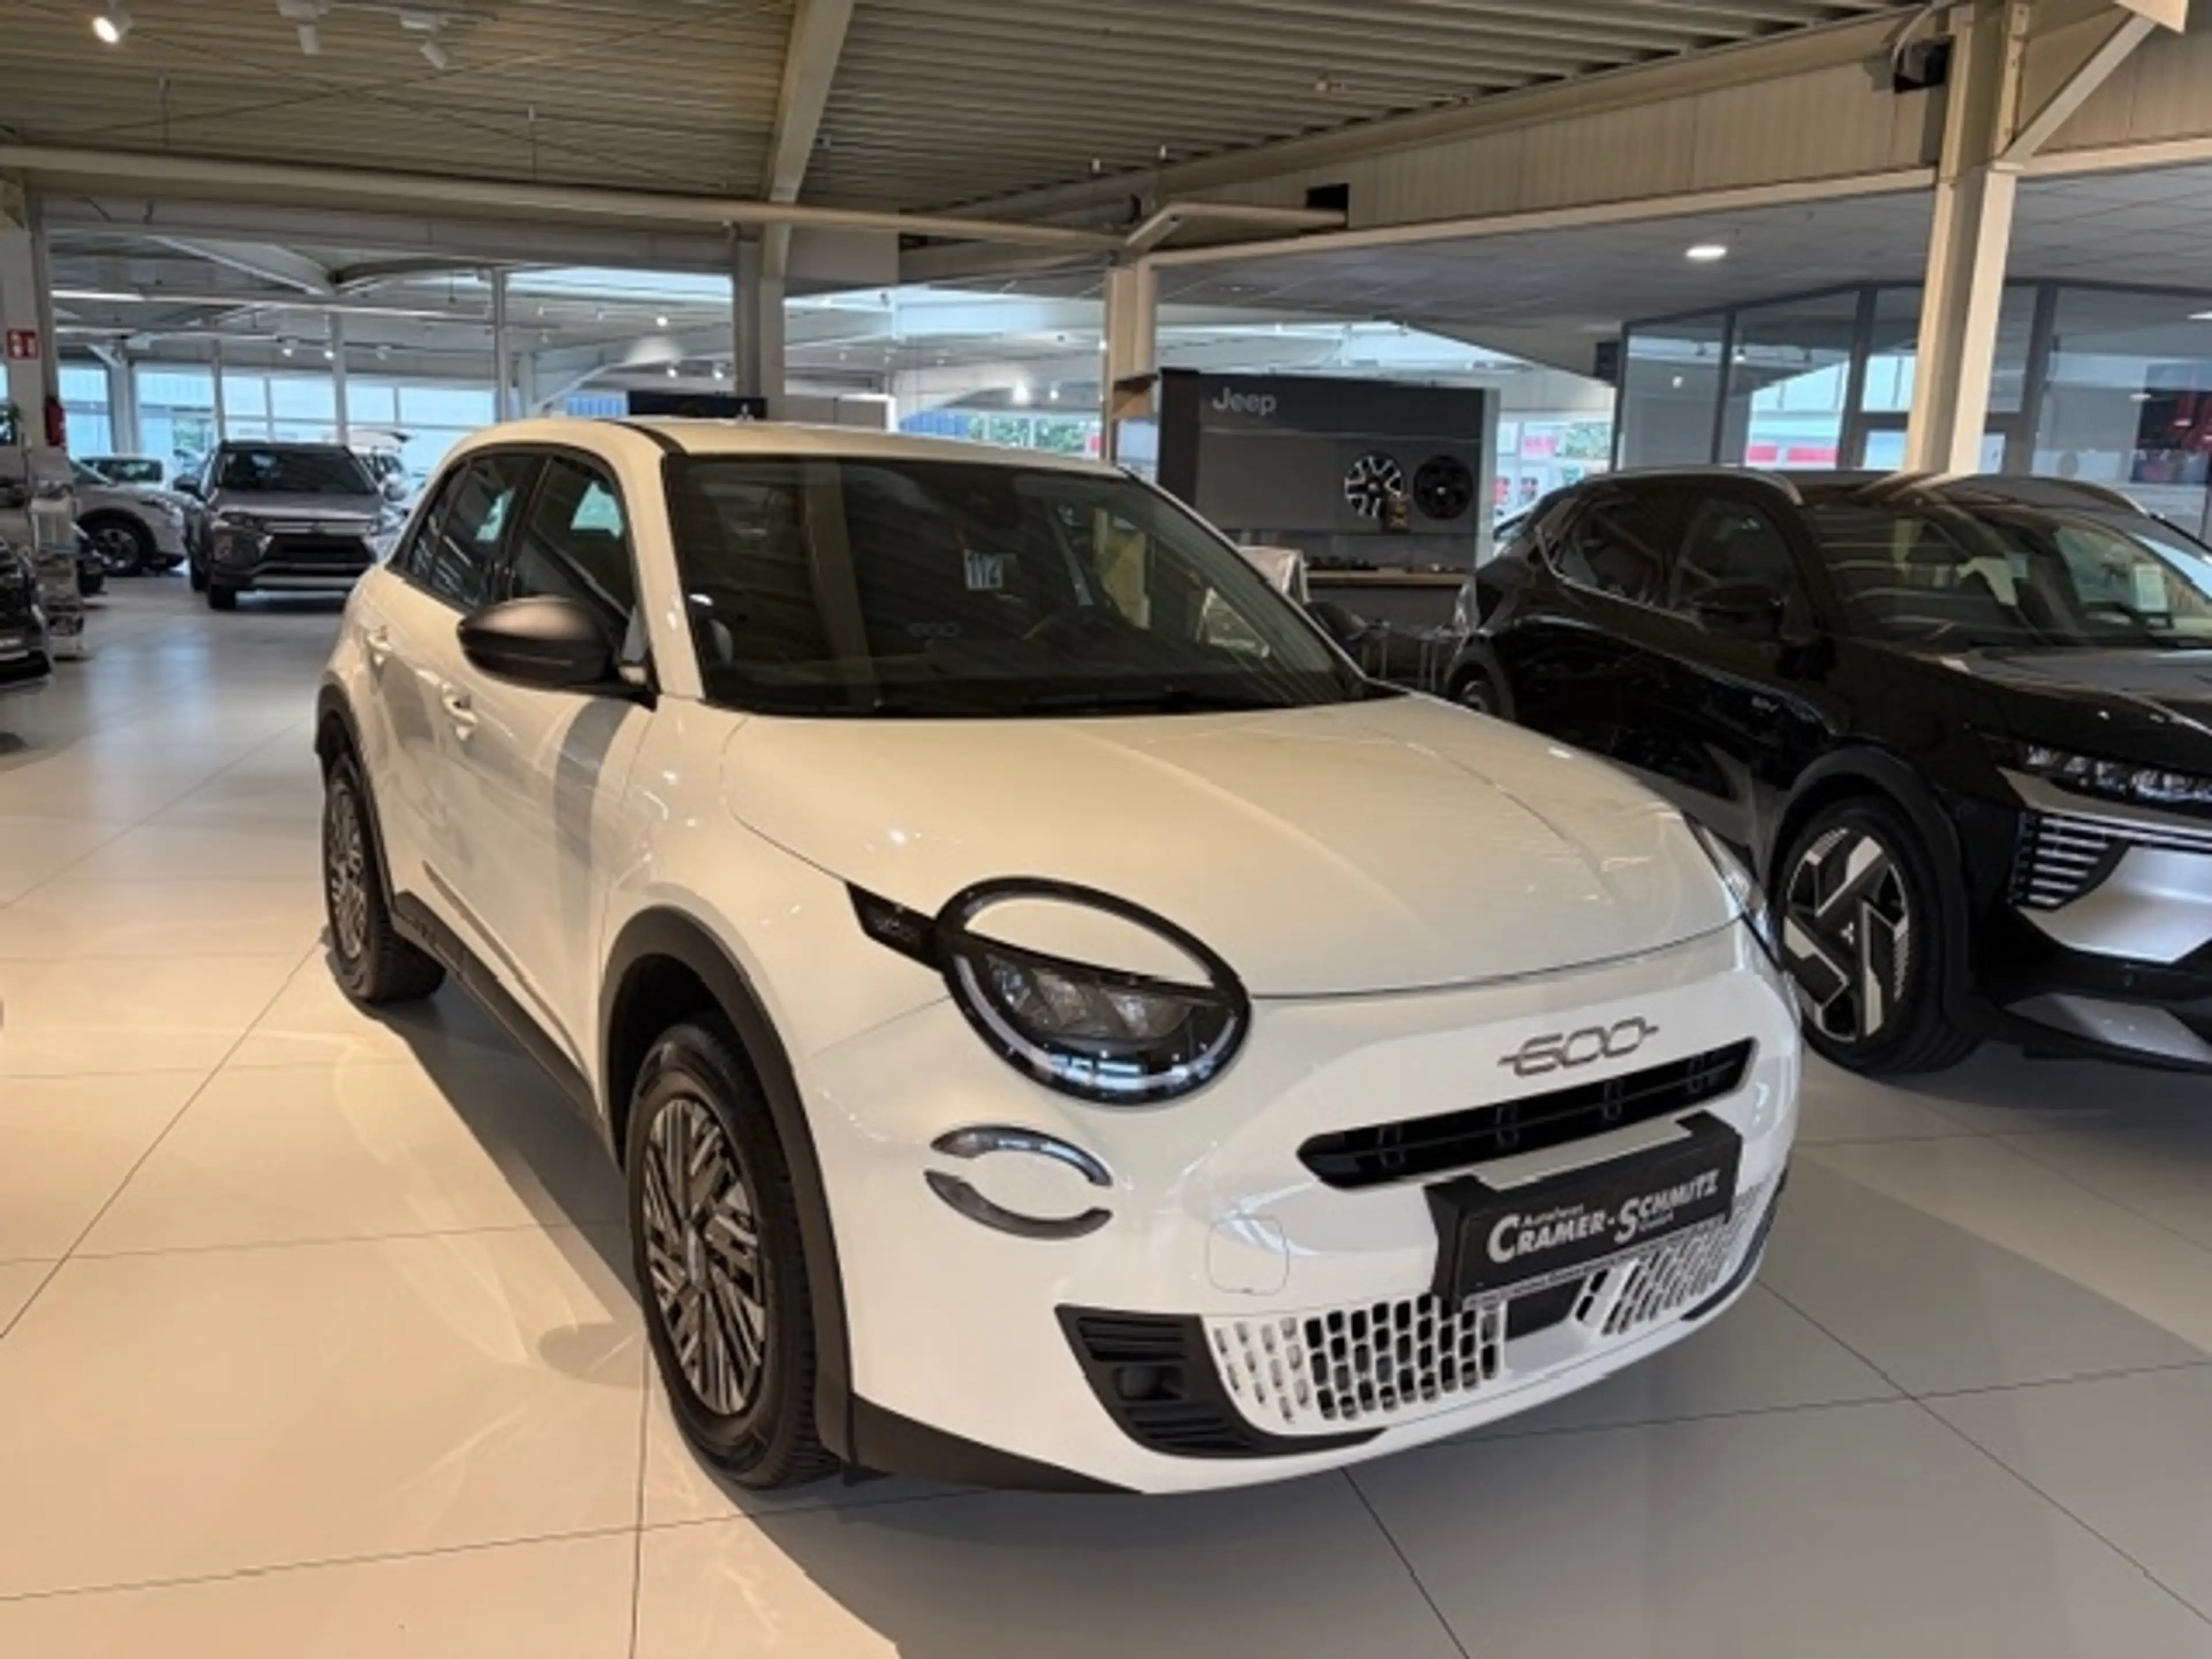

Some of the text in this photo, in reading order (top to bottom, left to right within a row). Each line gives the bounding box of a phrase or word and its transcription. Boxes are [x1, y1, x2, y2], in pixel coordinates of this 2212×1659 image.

[1211, 386, 1277, 415] Jeep
[1497, 1017, 1660, 1077] 600
[1486, 1168, 1721, 1263] CRAMER-SCHMITZ
